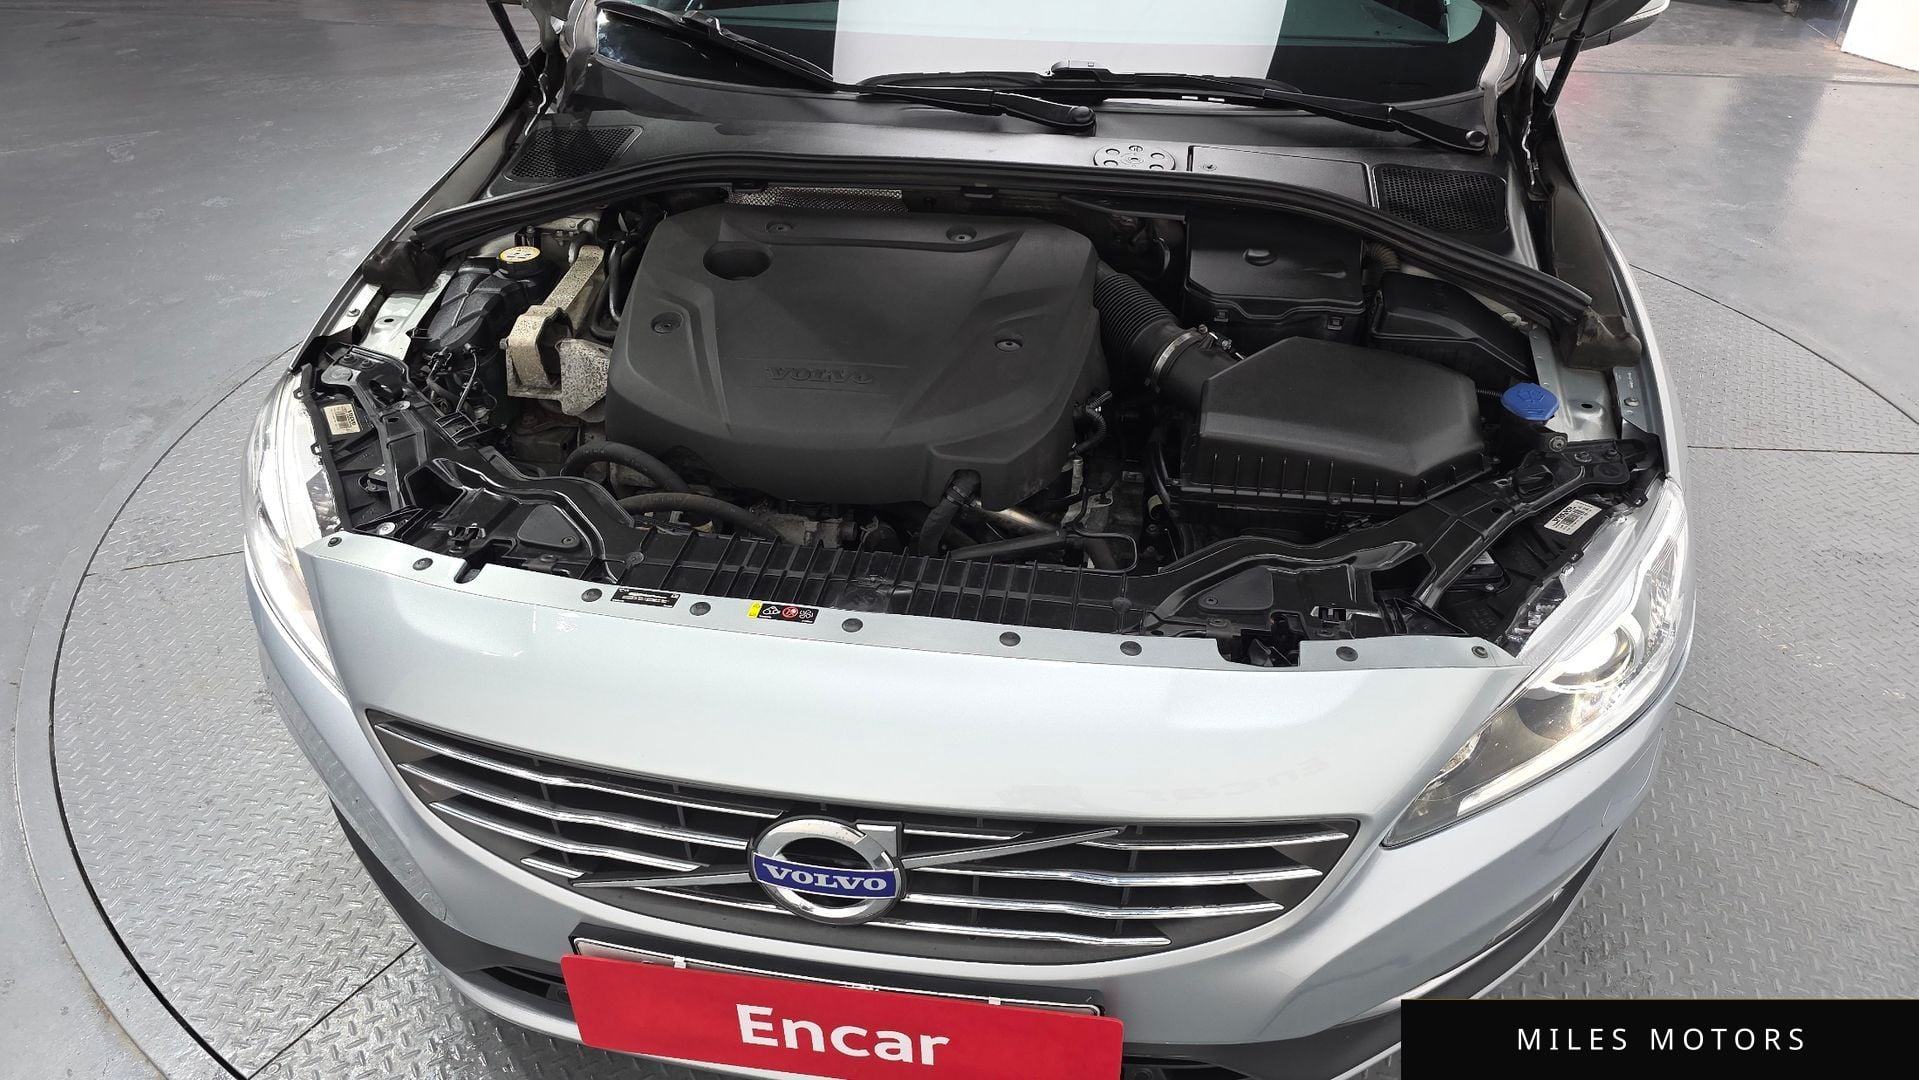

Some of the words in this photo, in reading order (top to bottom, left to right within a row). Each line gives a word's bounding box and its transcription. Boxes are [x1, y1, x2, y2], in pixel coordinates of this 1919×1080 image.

[766, 366, 873, 385] VOLVO
[762, 863, 887, 891] VOLVO
[736, 1003, 950, 1067] Encar
